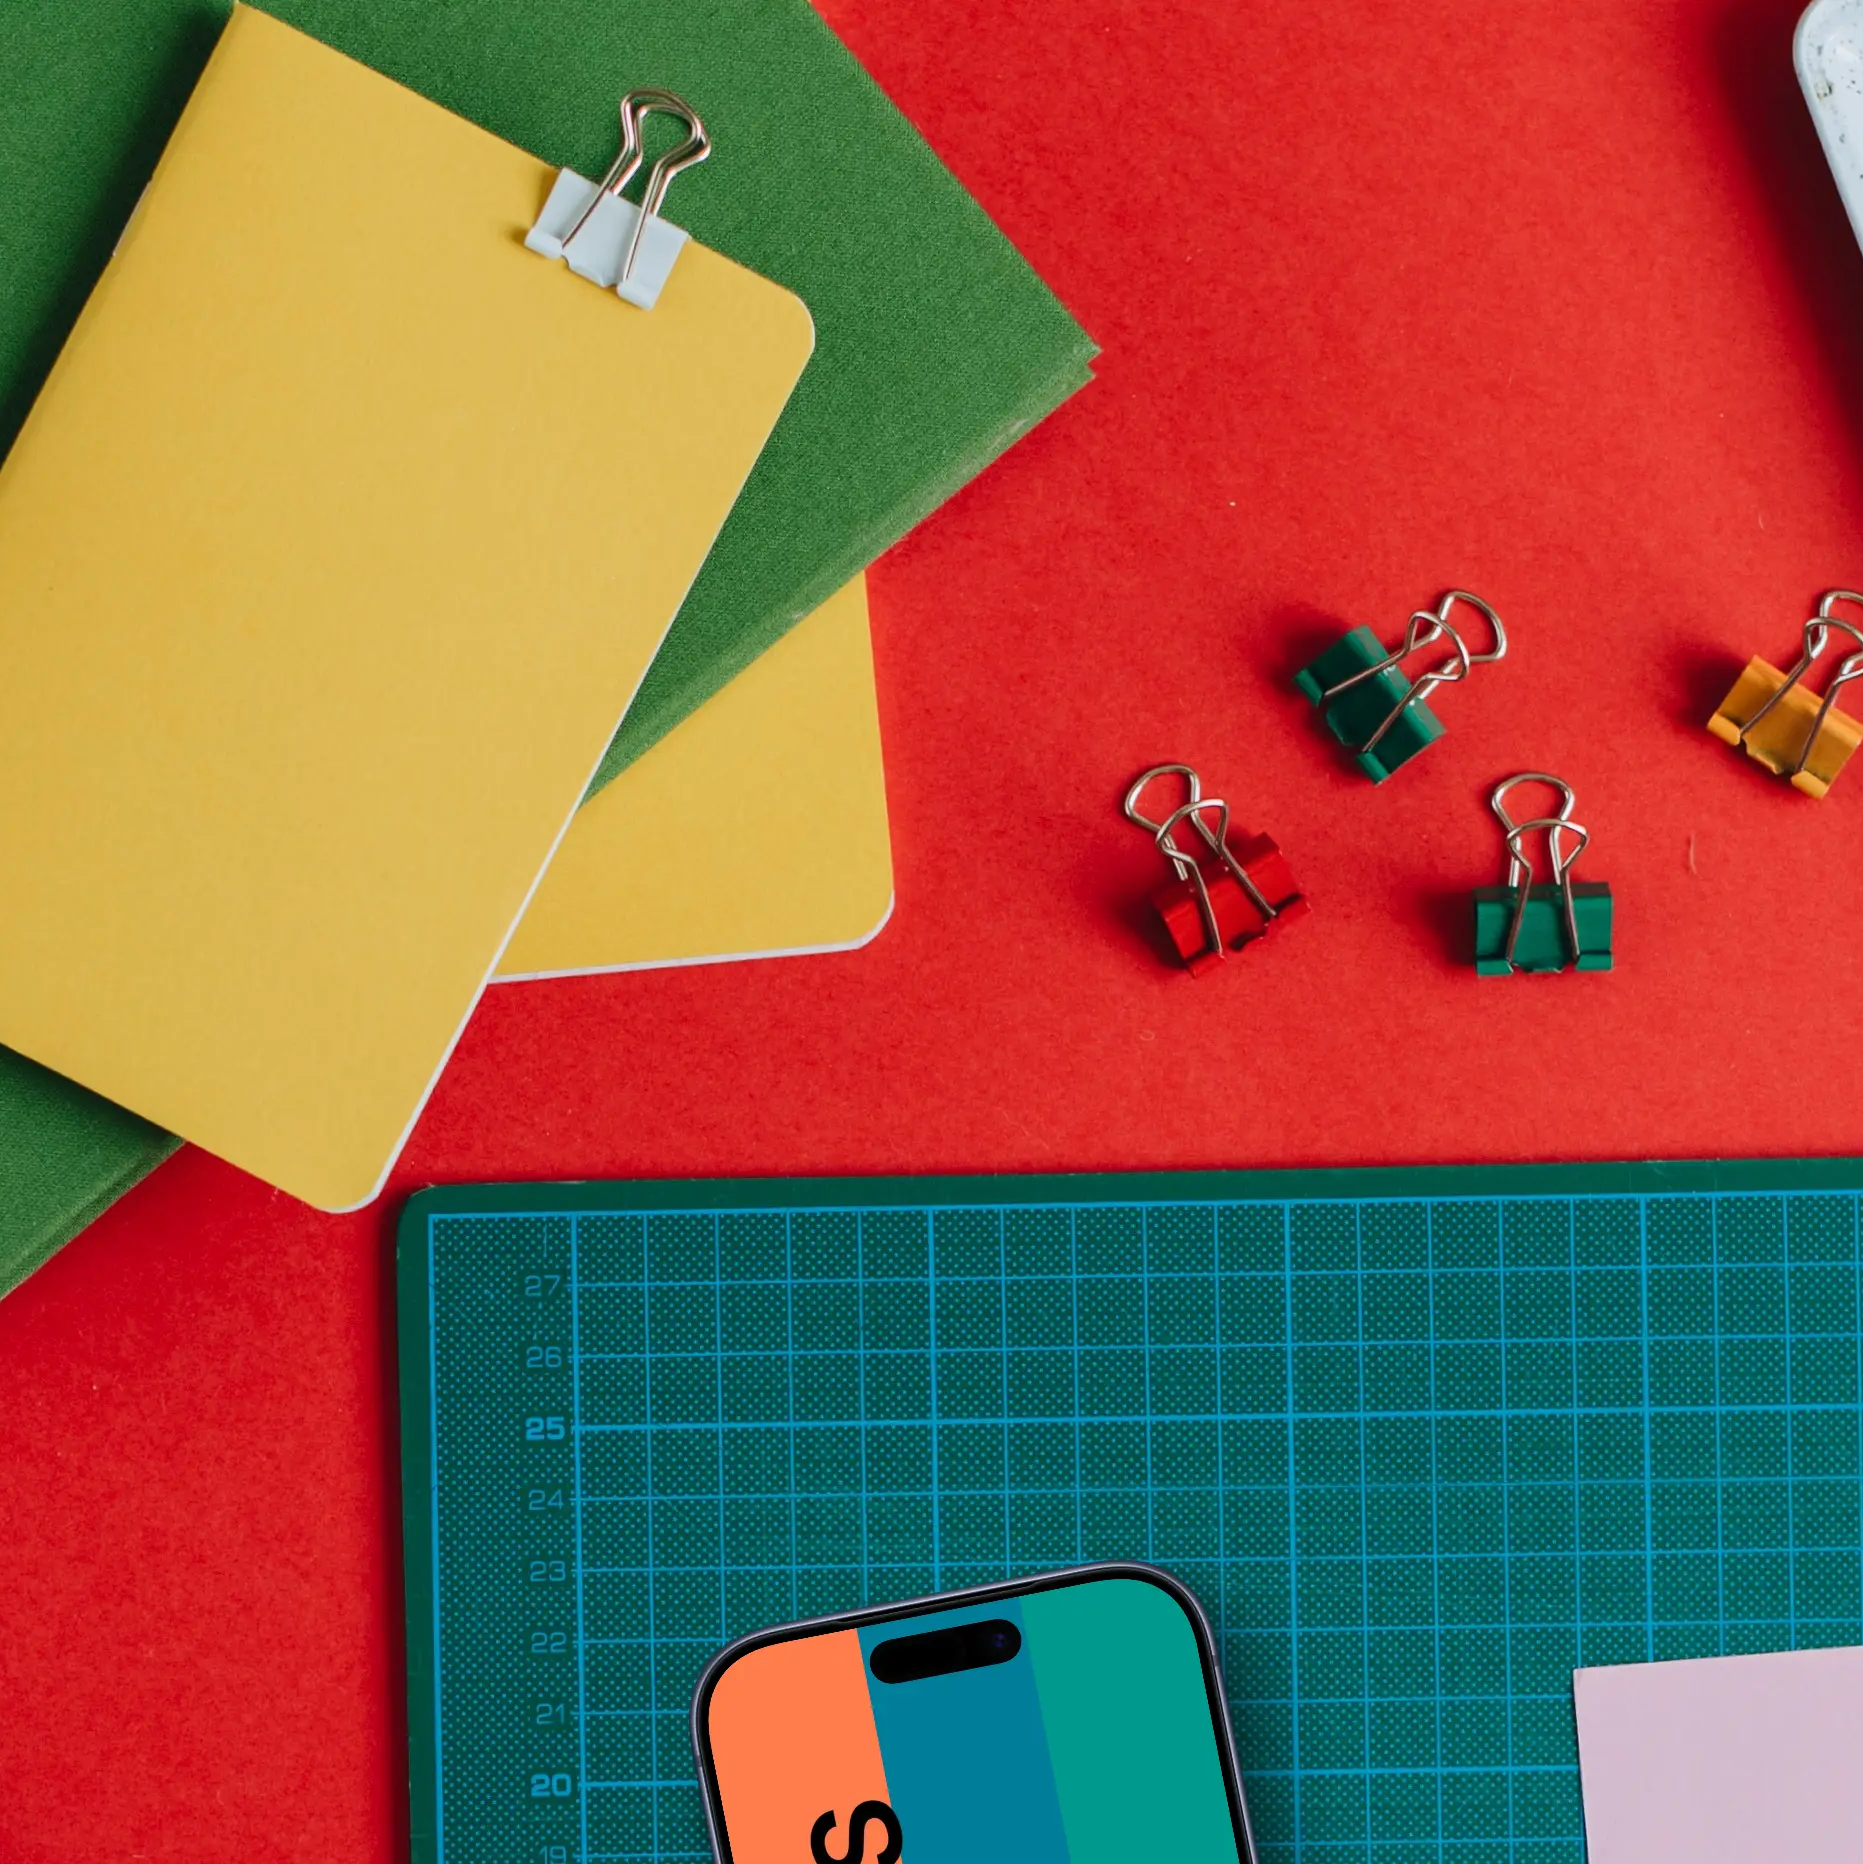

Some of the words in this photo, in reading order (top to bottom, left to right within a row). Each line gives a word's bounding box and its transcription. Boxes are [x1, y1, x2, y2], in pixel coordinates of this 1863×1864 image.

[524, 1275, 563, 1296] 27
[526, 1346, 563, 1368] 26
[525, 1417, 566, 1440] 25
[528, 1489, 565, 1510] 24
[530, 1561, 567, 1581] 23
[531, 1633, 567, 1653] 22
[536, 1704, 566, 1724] 21
[531, 1774, 572, 1797] 20
